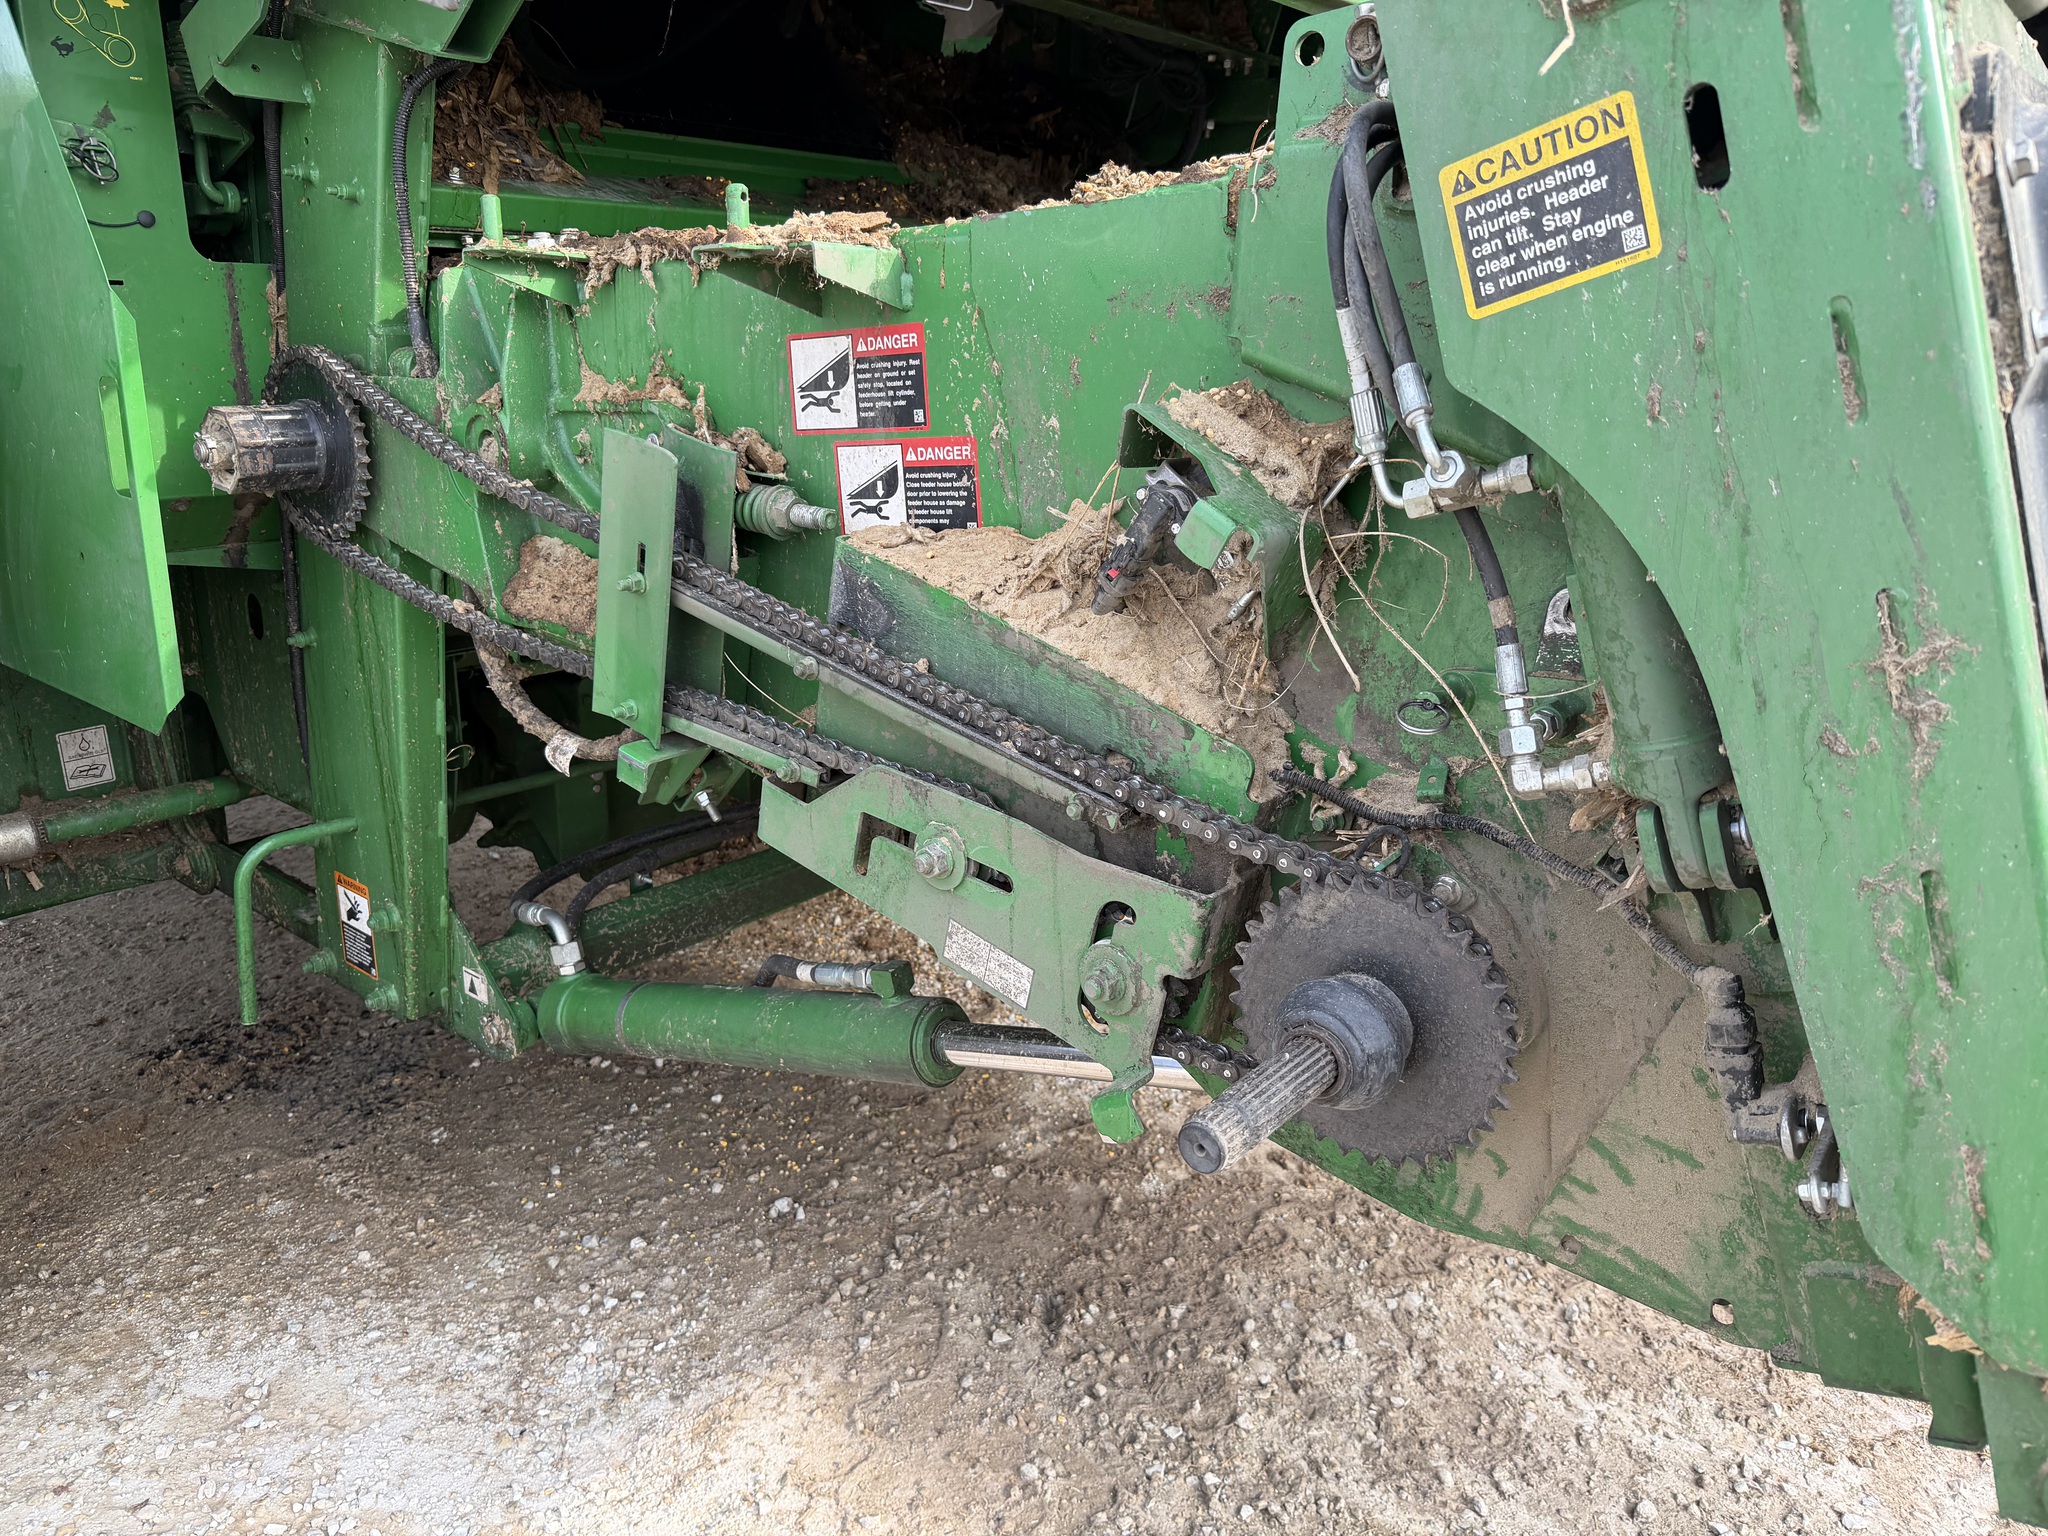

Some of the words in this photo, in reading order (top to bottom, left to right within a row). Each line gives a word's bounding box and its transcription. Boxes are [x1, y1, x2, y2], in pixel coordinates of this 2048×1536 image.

[1475, 103, 1626, 185] CAUTION
[1464, 191, 1513, 222] Avoid
[1516, 158, 1597, 201] crushing
[1467, 207, 1536, 241] injuries.
[1543, 174, 1610, 211] Header
[1471, 238, 1502, 260] can
[1505, 224, 1534, 248] tilt.
[1541, 207, 1582, 233] Stay
[1475, 252, 1517, 278] clear
[1520, 232, 1568, 261] when
[1571, 210, 1635, 243] engine
[1478, 280, 1495, 297] is
[1498, 255, 1571, 292] running.
[867, 333, 918, 351] DANGER
[871, 361, 891, 369] crushing
[909, 358, 920, 366] Rest
[882, 370, 899, 379] ground
[857, 382, 871, 390] safety
[875, 401, 891, 409] getting
[917, 446, 971, 461] DANGER
[920, 472, 942, 480] crushing
[919, 490, 931, 498] prior
[937, 490, 959, 498] lowering
[946, 499, 966, 507] damage
[939, 518, 950, 526] may
